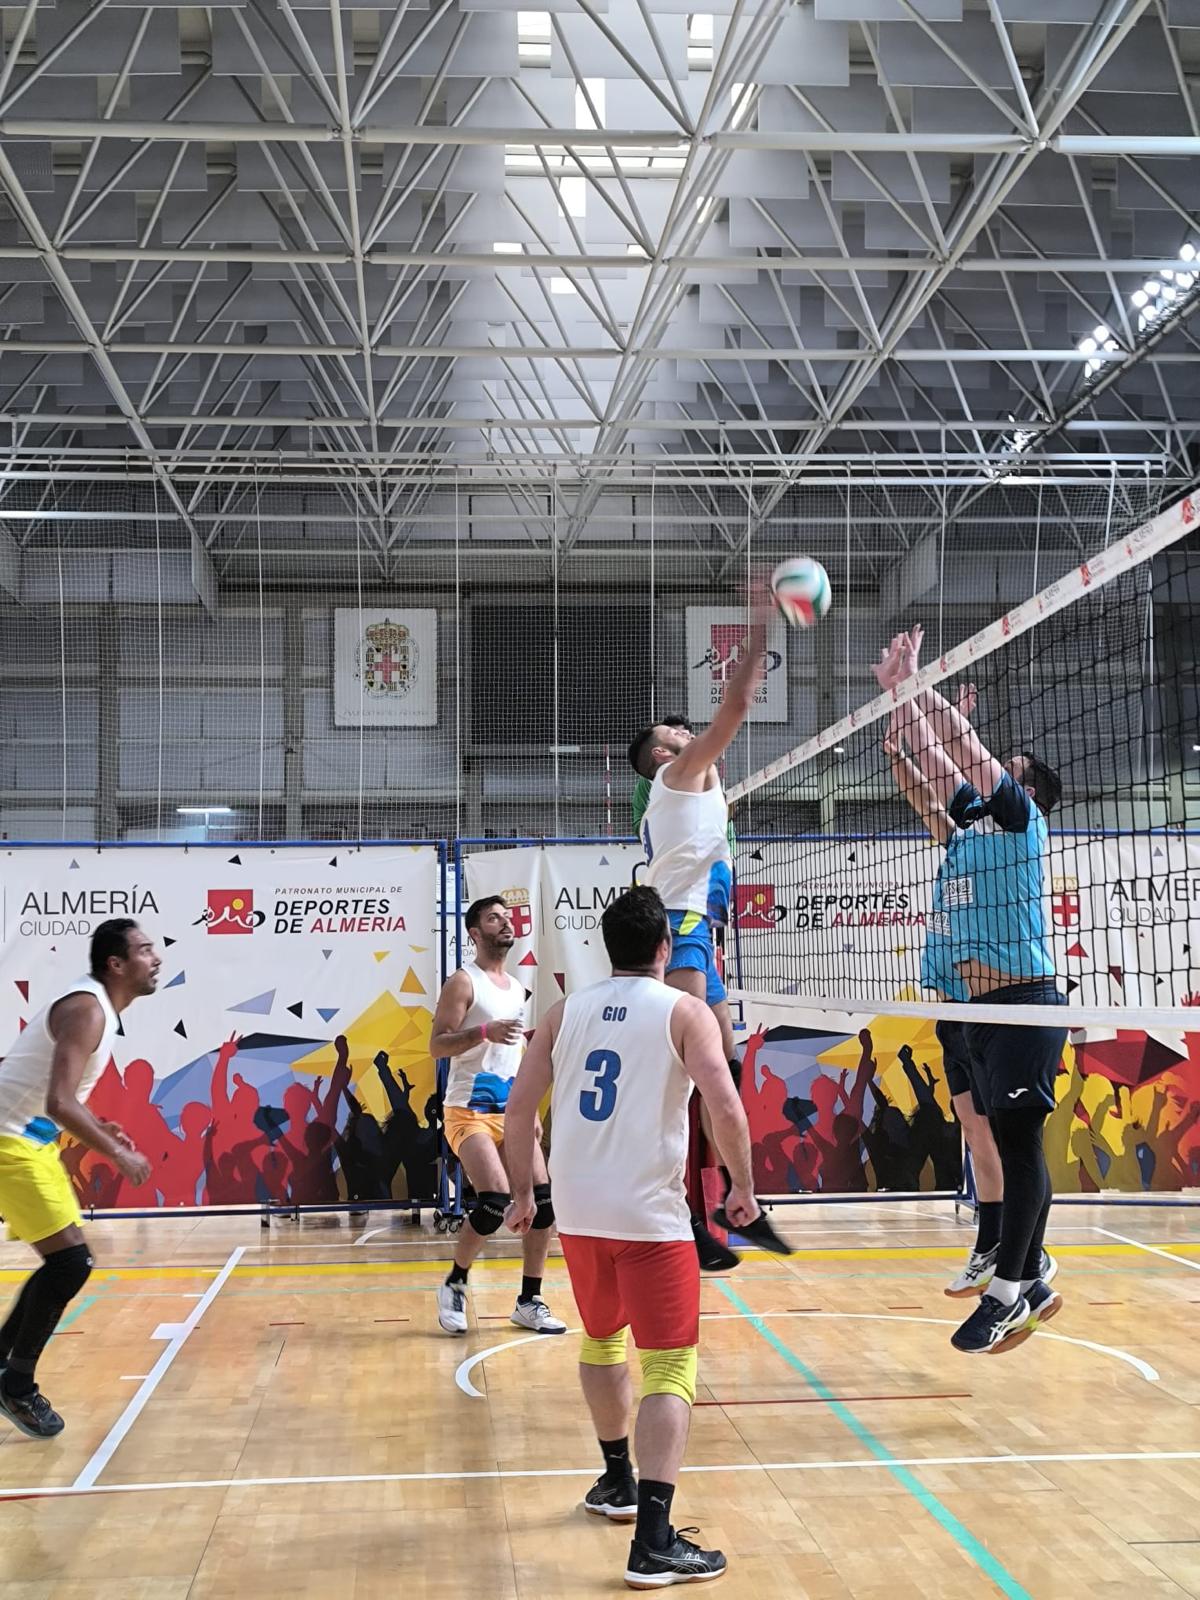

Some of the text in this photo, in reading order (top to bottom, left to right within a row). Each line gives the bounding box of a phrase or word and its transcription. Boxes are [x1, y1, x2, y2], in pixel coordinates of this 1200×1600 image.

[274, 887, 333, 895] PATRONATO
[336, 886, 386, 894] MUNICIPAL
[20, 884, 159, 915] ALMERÍA
[274, 899, 390, 916] DEPORTES
[796, 893, 909, 910] DEPORTES
[797, 913, 824, 928] DE
[831, 911, 926, 927] ALMERIA
[1110, 907, 1176, 922] CIUDAD
[19, 920, 91, 936] CIUDAD
[274, 916, 407, 934] DE ALMERIA
[602, 1006, 627, 1021] GIO
[579, 1049, 621, 1121] 3
